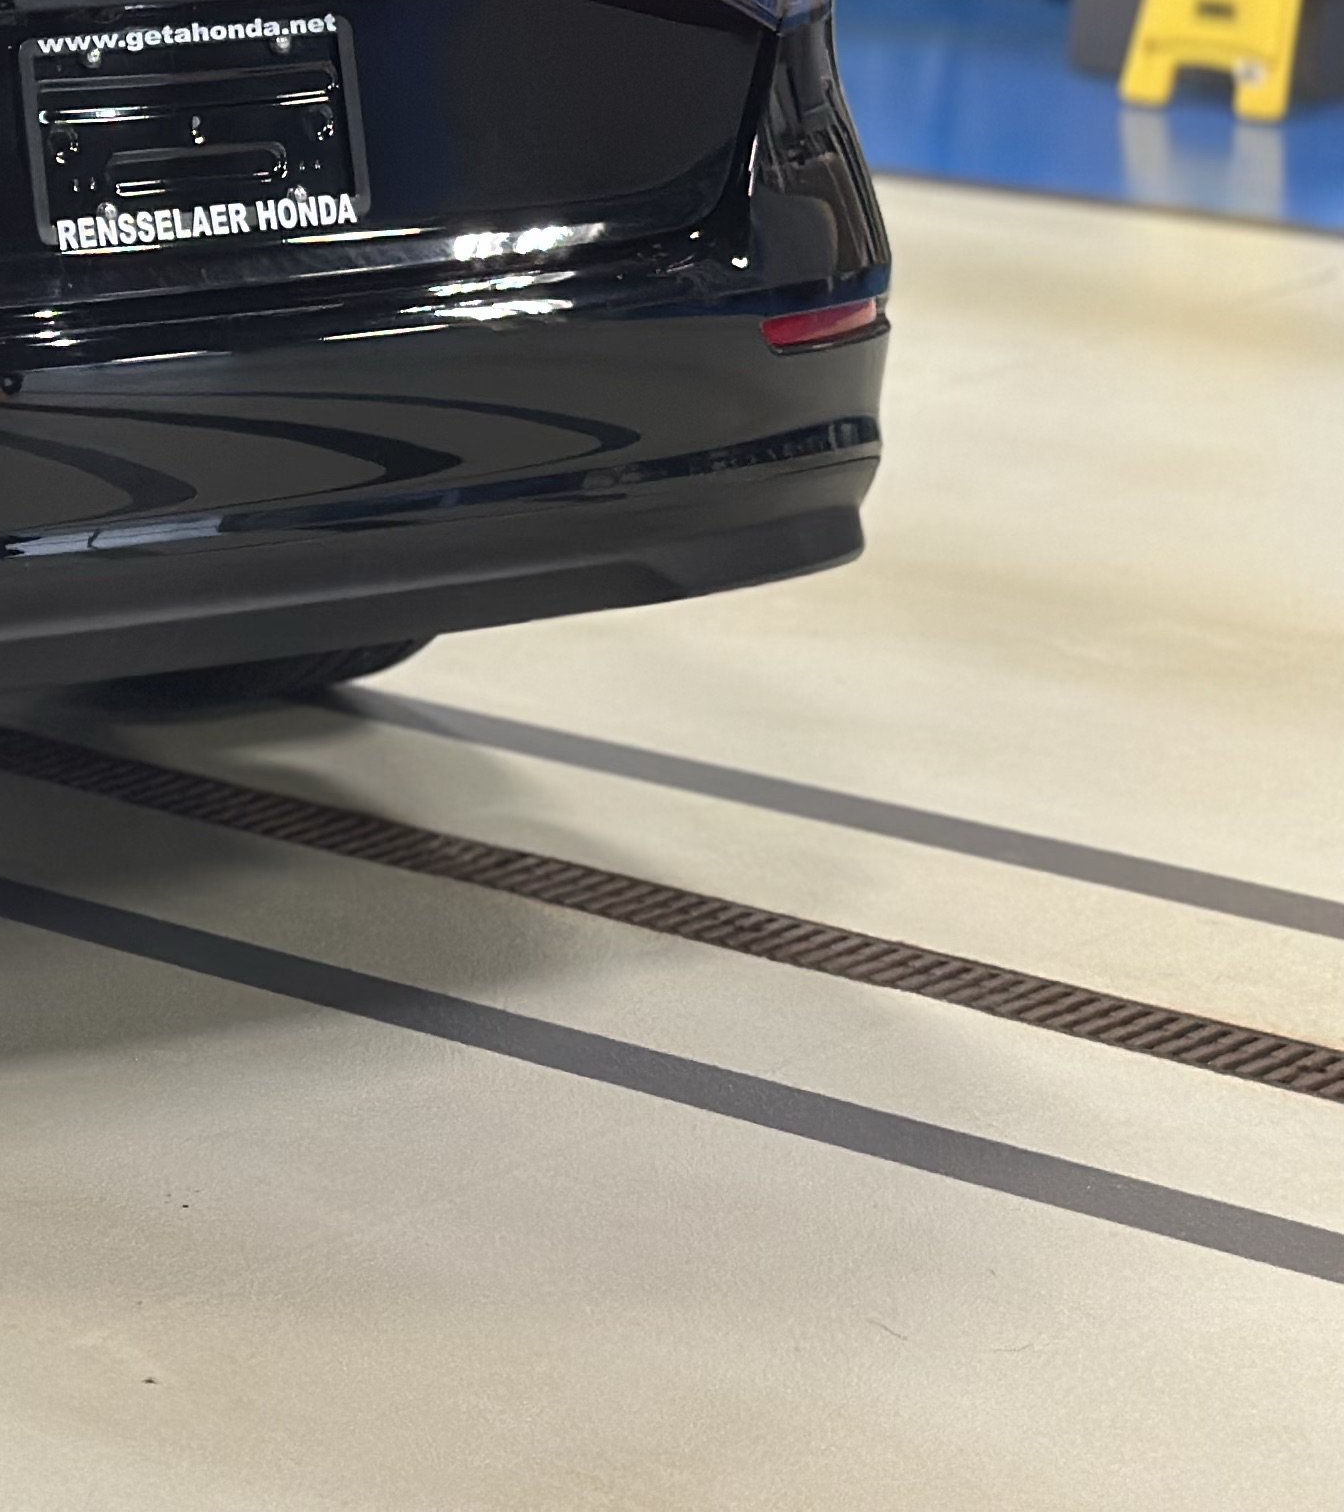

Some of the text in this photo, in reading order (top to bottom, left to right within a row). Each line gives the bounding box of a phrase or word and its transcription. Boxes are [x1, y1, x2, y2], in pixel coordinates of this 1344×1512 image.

[37, 13, 337, 59] www.getahonda.net
[56, 193, 358, 251] RENSSELAER HONDA
